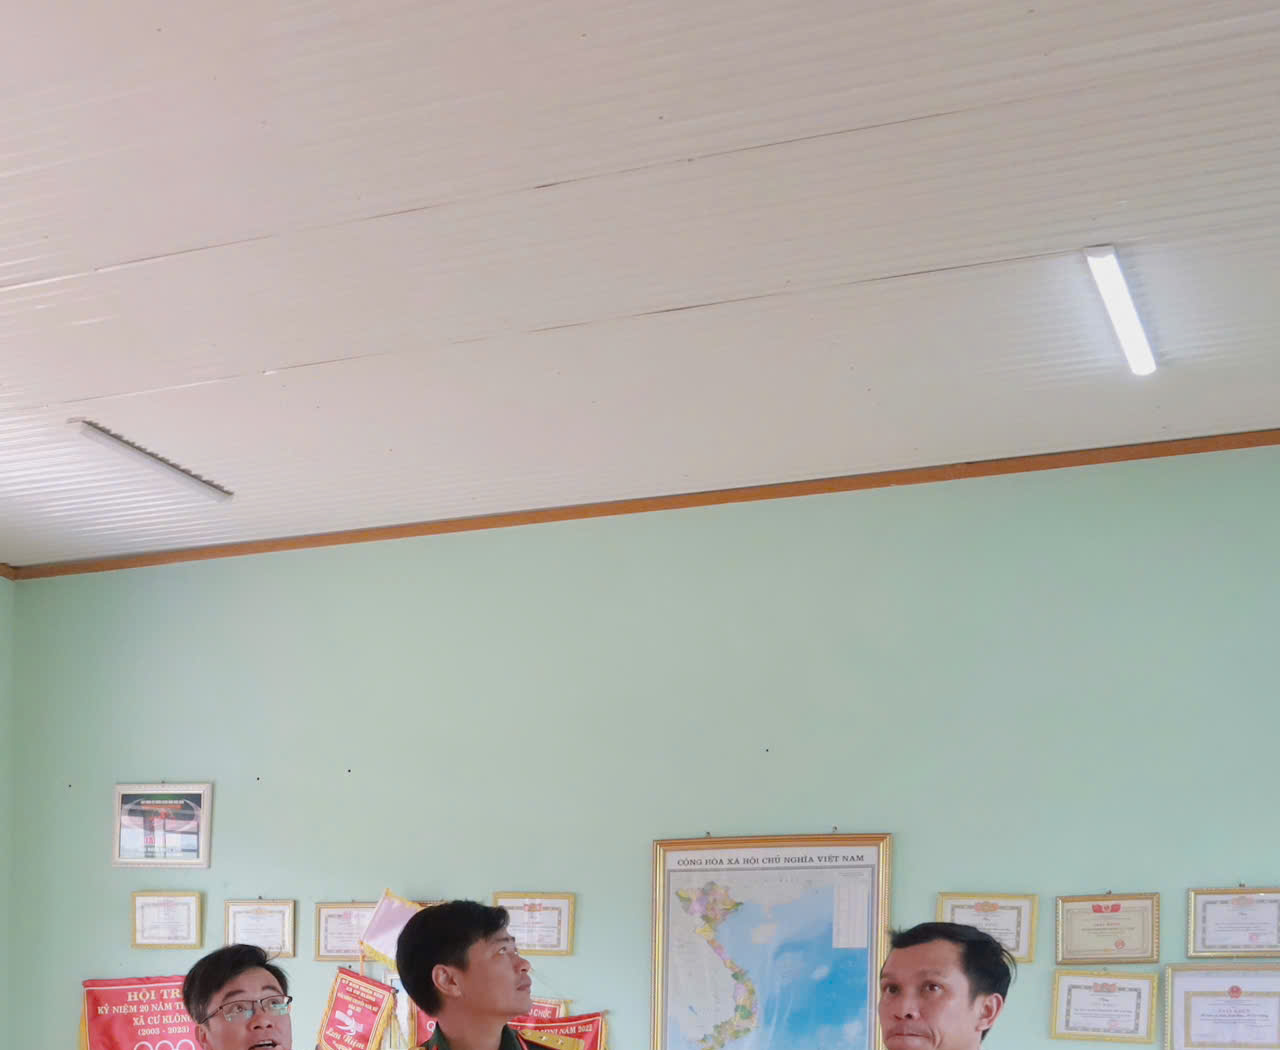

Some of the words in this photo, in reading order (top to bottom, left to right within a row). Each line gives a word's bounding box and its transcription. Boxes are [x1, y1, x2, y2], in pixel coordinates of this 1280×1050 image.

[677, 856, 702, 867] CỘNG
[727, 855, 740, 865] XÃ
[743, 855, 759, 866] HỘI
[762, 854, 781, 864] CHỦ
[783, 855, 814, 864] NGHĨA
[817, 854, 840, 864] VIỆT
[842, 854, 865, 862] NAM
[127, 988, 156, 1003] HỘI
[160, 988, 182, 998] TR
